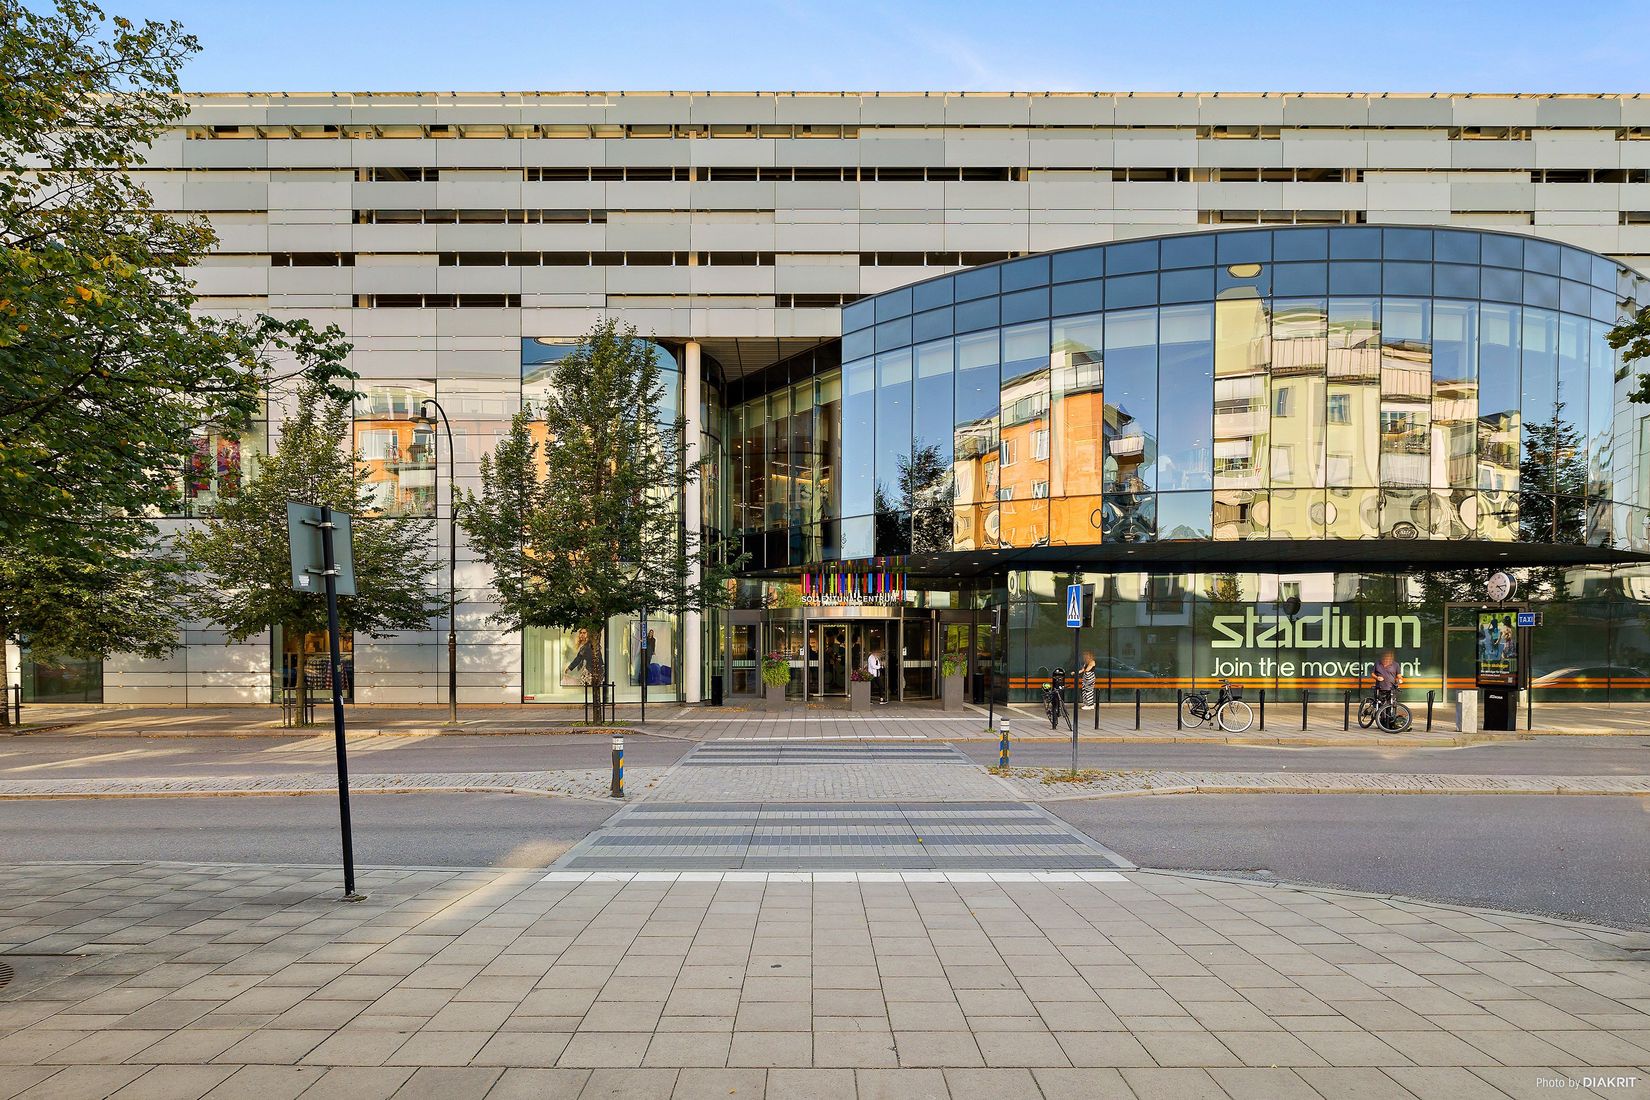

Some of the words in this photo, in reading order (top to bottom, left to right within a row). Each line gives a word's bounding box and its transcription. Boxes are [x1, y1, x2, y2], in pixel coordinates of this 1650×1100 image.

[801, 595, 855, 603] SOLLENTUNA
[857, 595, 897, 603] CENTRUM
[1211, 606, 1421, 648] stadium
[1211, 657, 1253, 677] Join
[1259, 657, 1295, 677] the
[1301, 657, 1422, 677] movent
